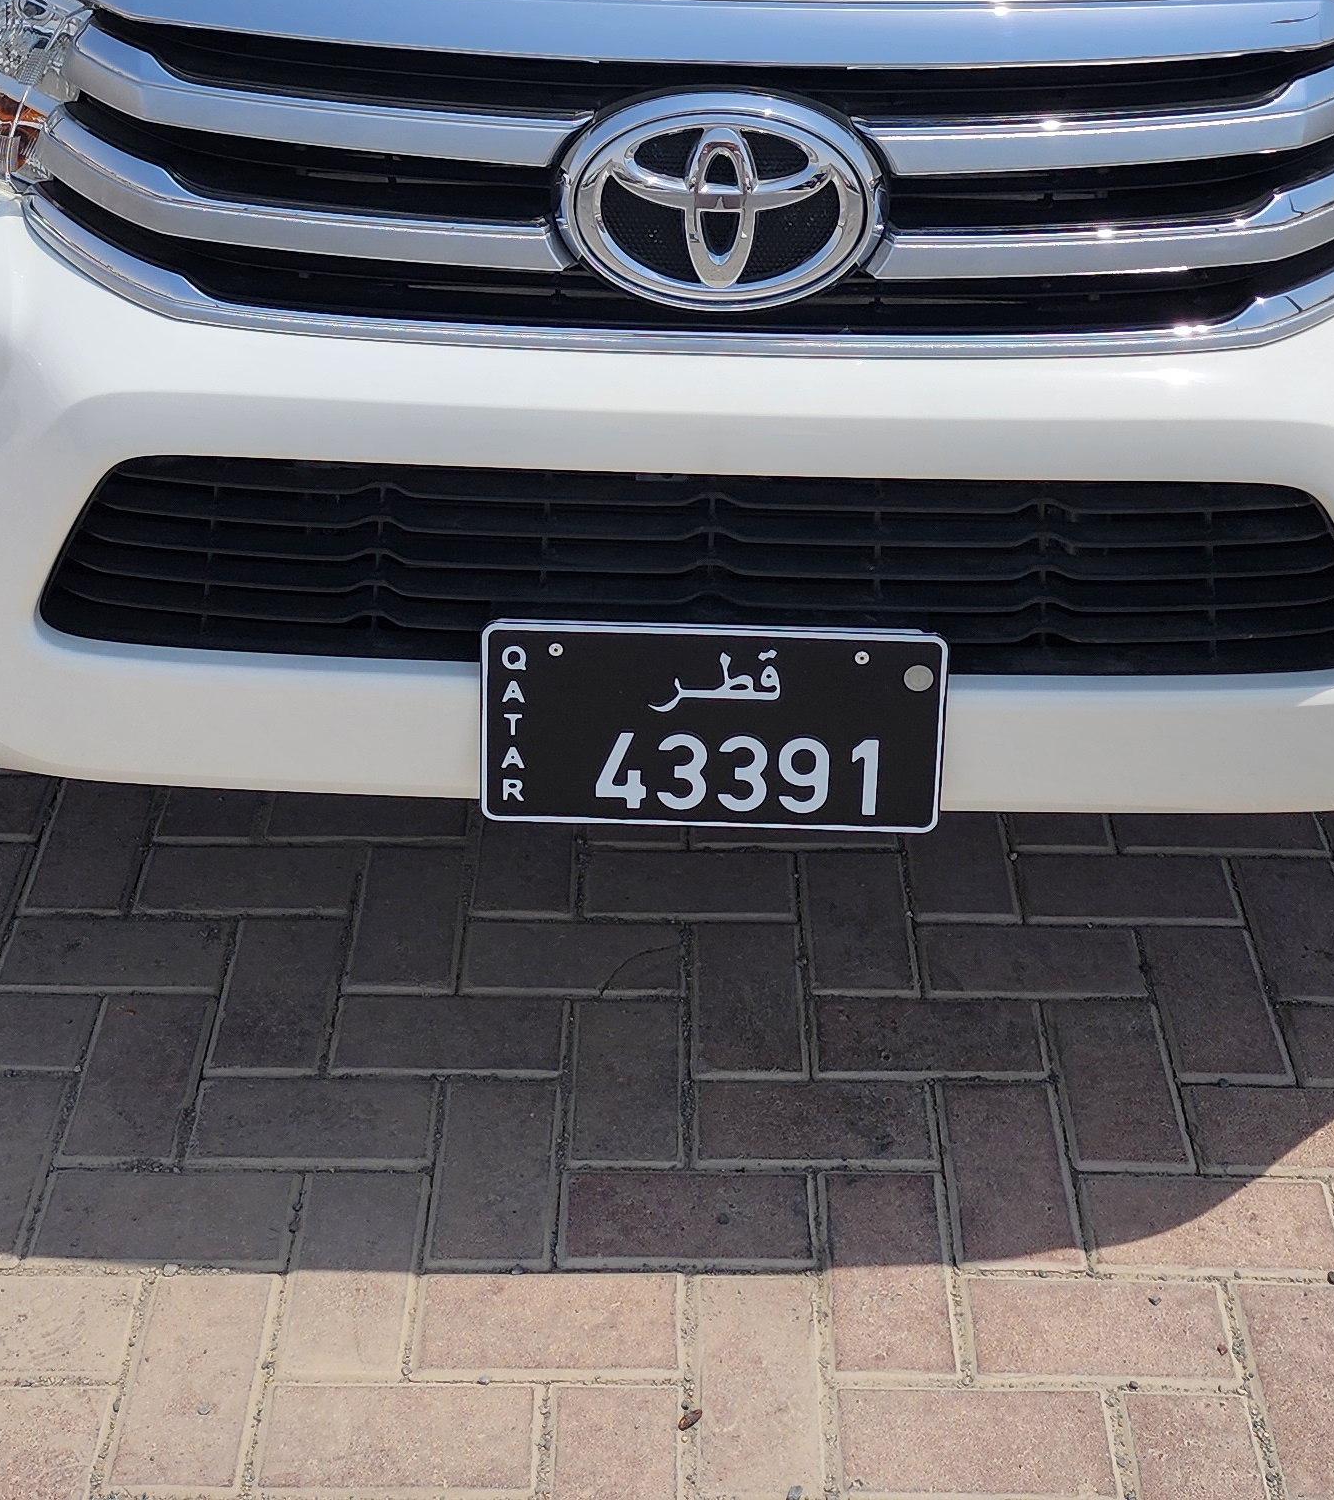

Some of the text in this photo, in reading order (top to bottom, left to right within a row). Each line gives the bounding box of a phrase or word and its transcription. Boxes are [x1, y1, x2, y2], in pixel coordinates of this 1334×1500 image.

[500, 645, 527, 802] QATAR
[647, 649, 781, 713] قطر
[594, 731, 880, 816] 43391
